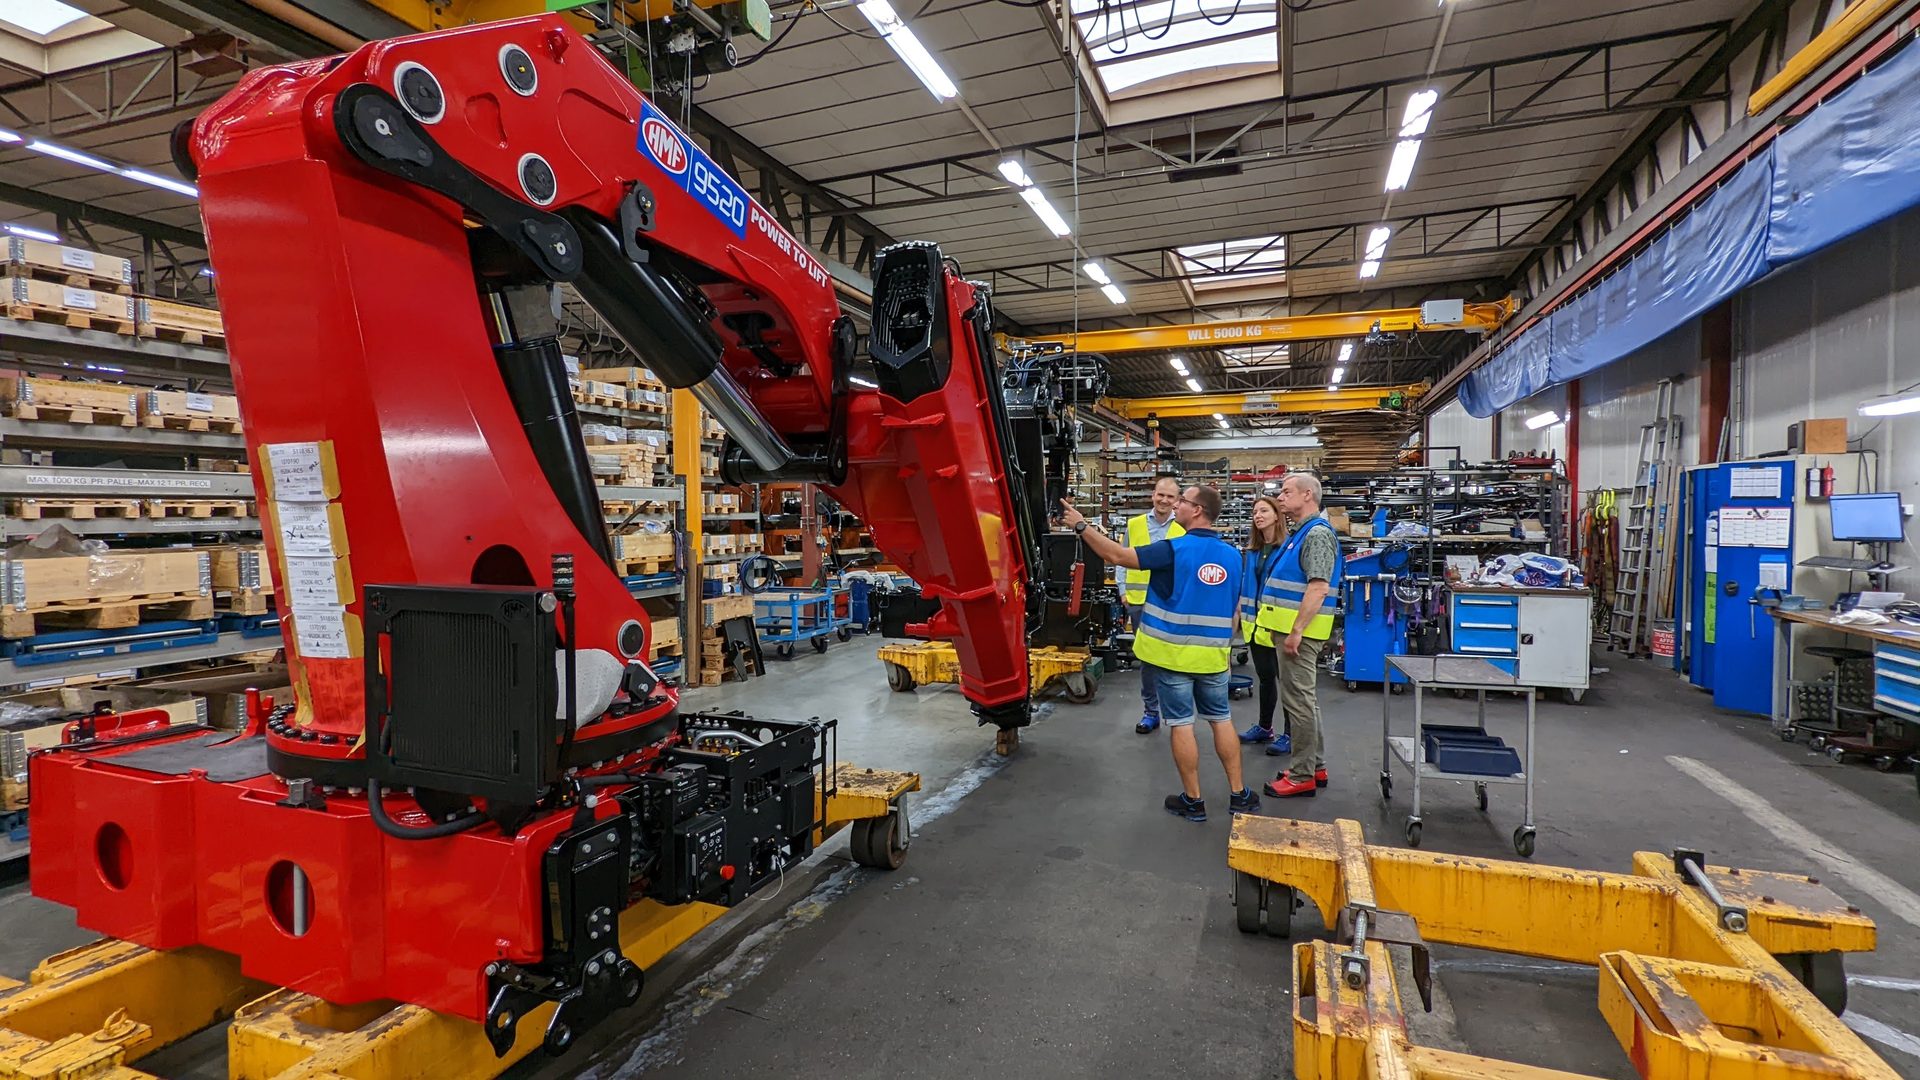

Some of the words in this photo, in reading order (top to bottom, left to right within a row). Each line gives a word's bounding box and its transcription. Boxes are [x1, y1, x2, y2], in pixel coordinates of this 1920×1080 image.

[649, 124, 682, 168] HMF
[693, 161, 745, 228] 9520
[751, 206, 791, 256] POWER
[793, 245, 808, 270] TO
[808, 261, 828, 288] LIFT
[1187, 329, 1211, 341] WLL
[1214, 326, 1243, 339] 5000
[1246, 325, 1262, 337] KG
[1202, 567, 1223, 582] HMF
